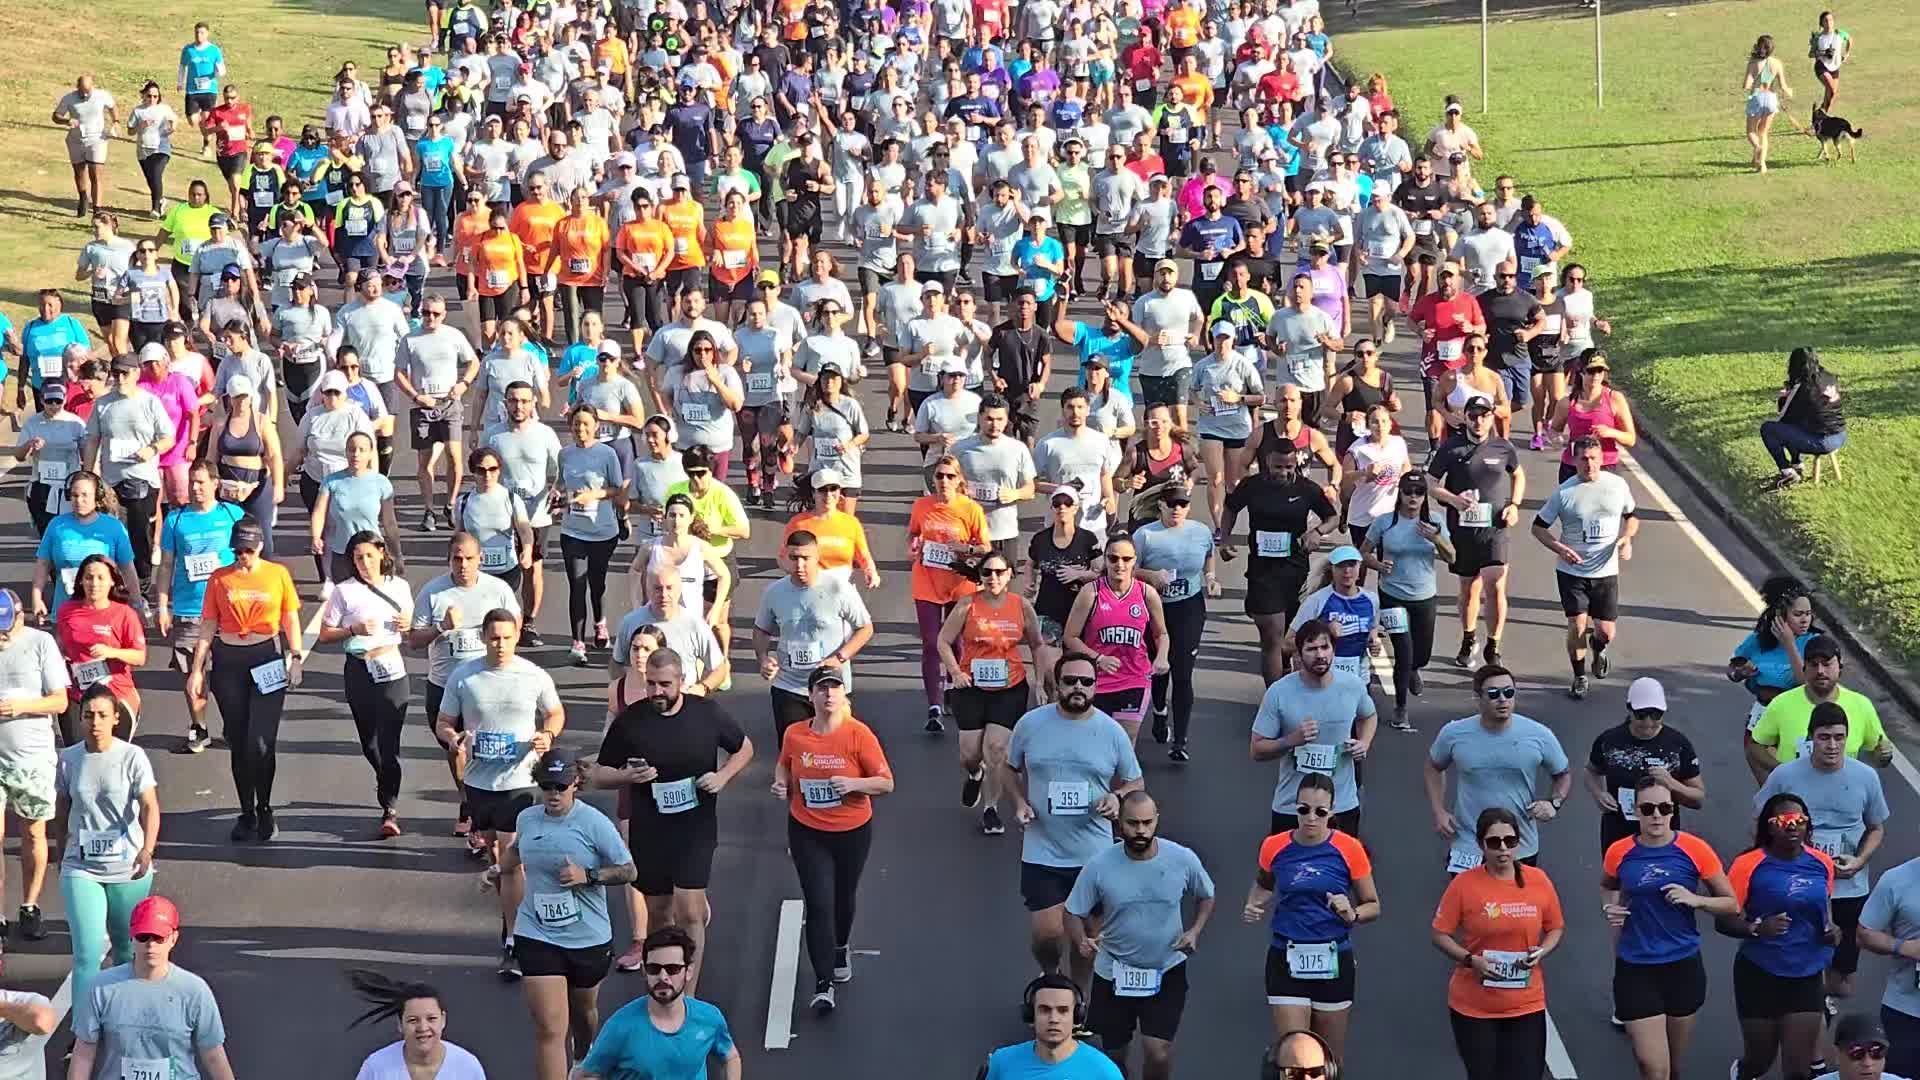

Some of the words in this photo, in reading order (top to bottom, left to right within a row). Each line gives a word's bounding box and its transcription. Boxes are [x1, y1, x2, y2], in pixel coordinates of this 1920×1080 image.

[1099, 626, 1142, 648] VASCO
[1305, 753, 1327, 767] 7651
[663, 790, 686, 804] 6906
[1061, 791, 1079, 806] 353
[543, 905, 570, 918] 7645
[1299, 955, 1324, 971] 3175
[1124, 971, 1148, 987] 1390
